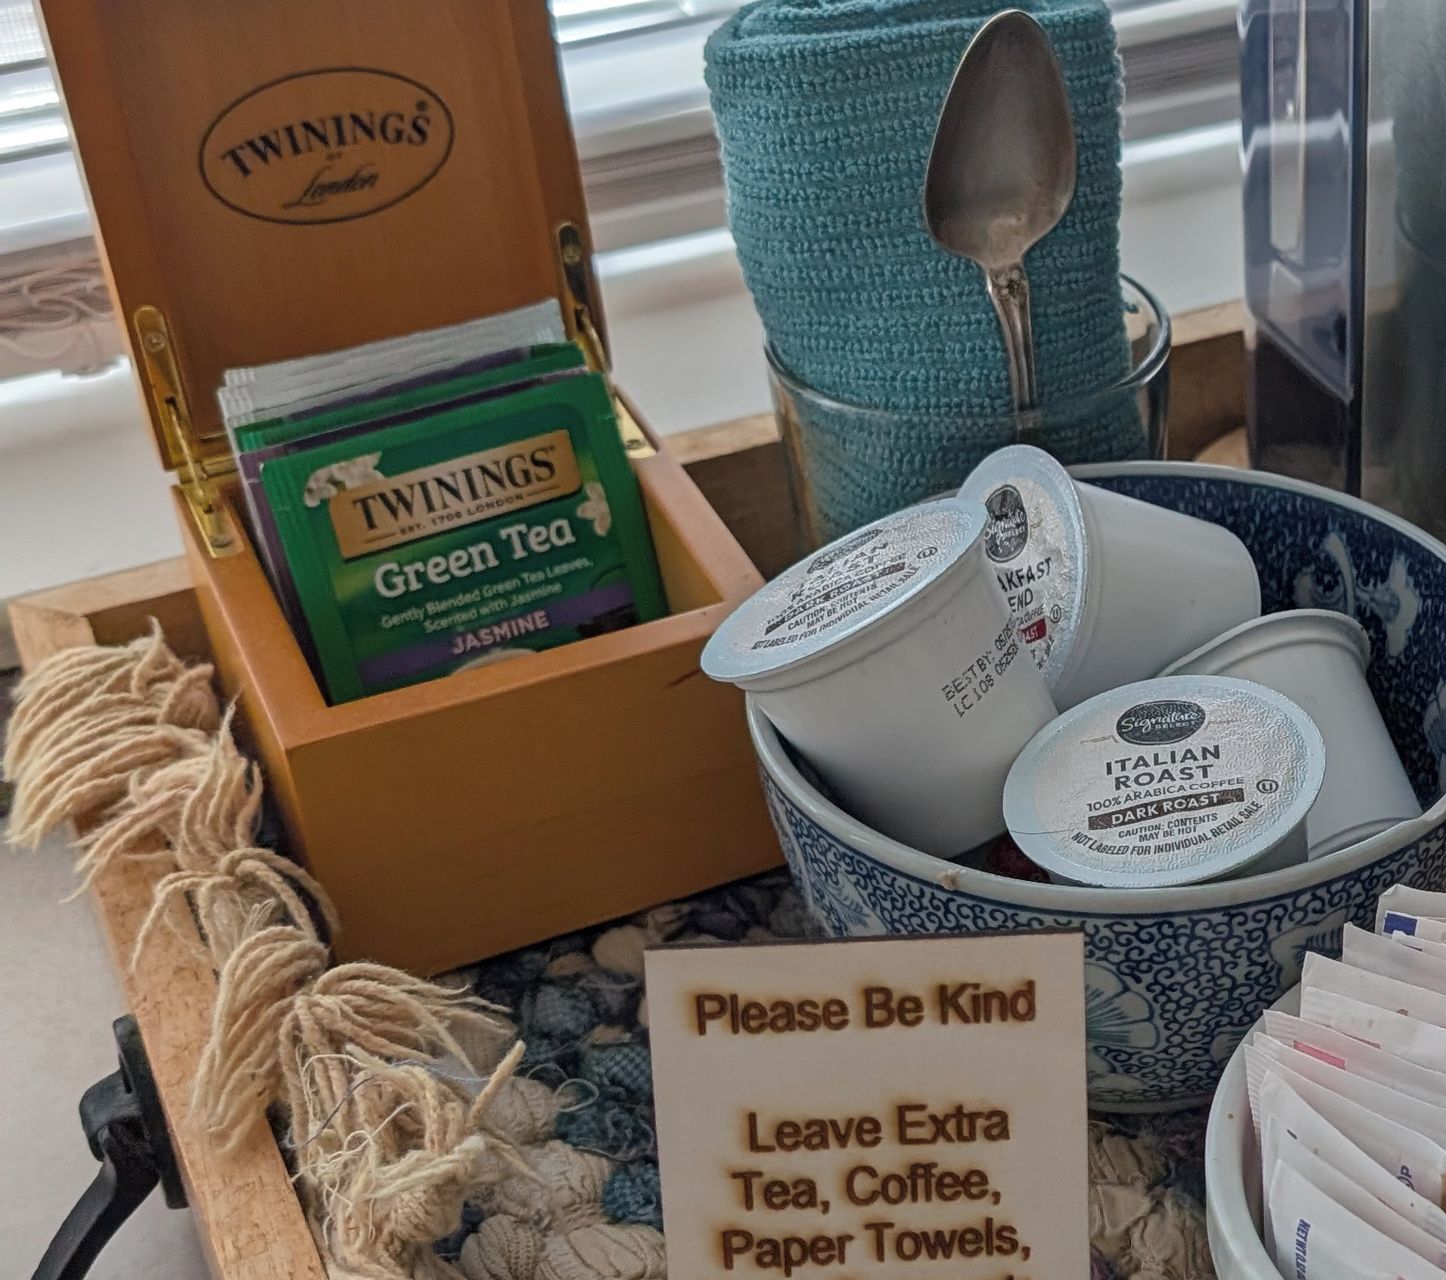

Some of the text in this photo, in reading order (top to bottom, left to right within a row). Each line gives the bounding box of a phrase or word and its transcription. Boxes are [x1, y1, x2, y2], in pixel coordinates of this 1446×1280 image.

[220, 111, 431, 178] TWININGS
[353, 446, 556, 531] TWININGS
[467, 492, 525, 516] LONDON
[374, 518, 576, 599] Green Tea
[480, 599, 510, 619] with
[511, 582, 563, 608] Jasmine
[482, 576, 521, 598] Green
[524, 568, 546, 585] Tea
[452, 610, 550, 655] JASMINE
[806, 614, 826, 629] MAY
[1121, 708, 1201, 733] Signature
[1154, 721, 1195, 731] SELECT
[1105, 744, 1220, 776] ITALIAN
[1114, 763, 1214, 791] ROAST
[1087, 776, 1245, 812] 100% ARABICA COFFEE
[1111, 793, 1221, 825] DARK ROAST
[1071, 800, 1264, 856] NOT LABELED FOR INDIVIDUAL RETAIL SALE
[1118, 812, 1218, 839] CAUTION: CONTENTS
[1138, 825, 1199, 843] MAY BE HOT
[695, 980, 1036, 1036] Please Be Kind
[747, 1104, 1011, 1154] Leave Extra
[732, 1163, 1002, 1215] Tea, Coffee,
[721, 1217, 1031, 1277] Paper Towels,
